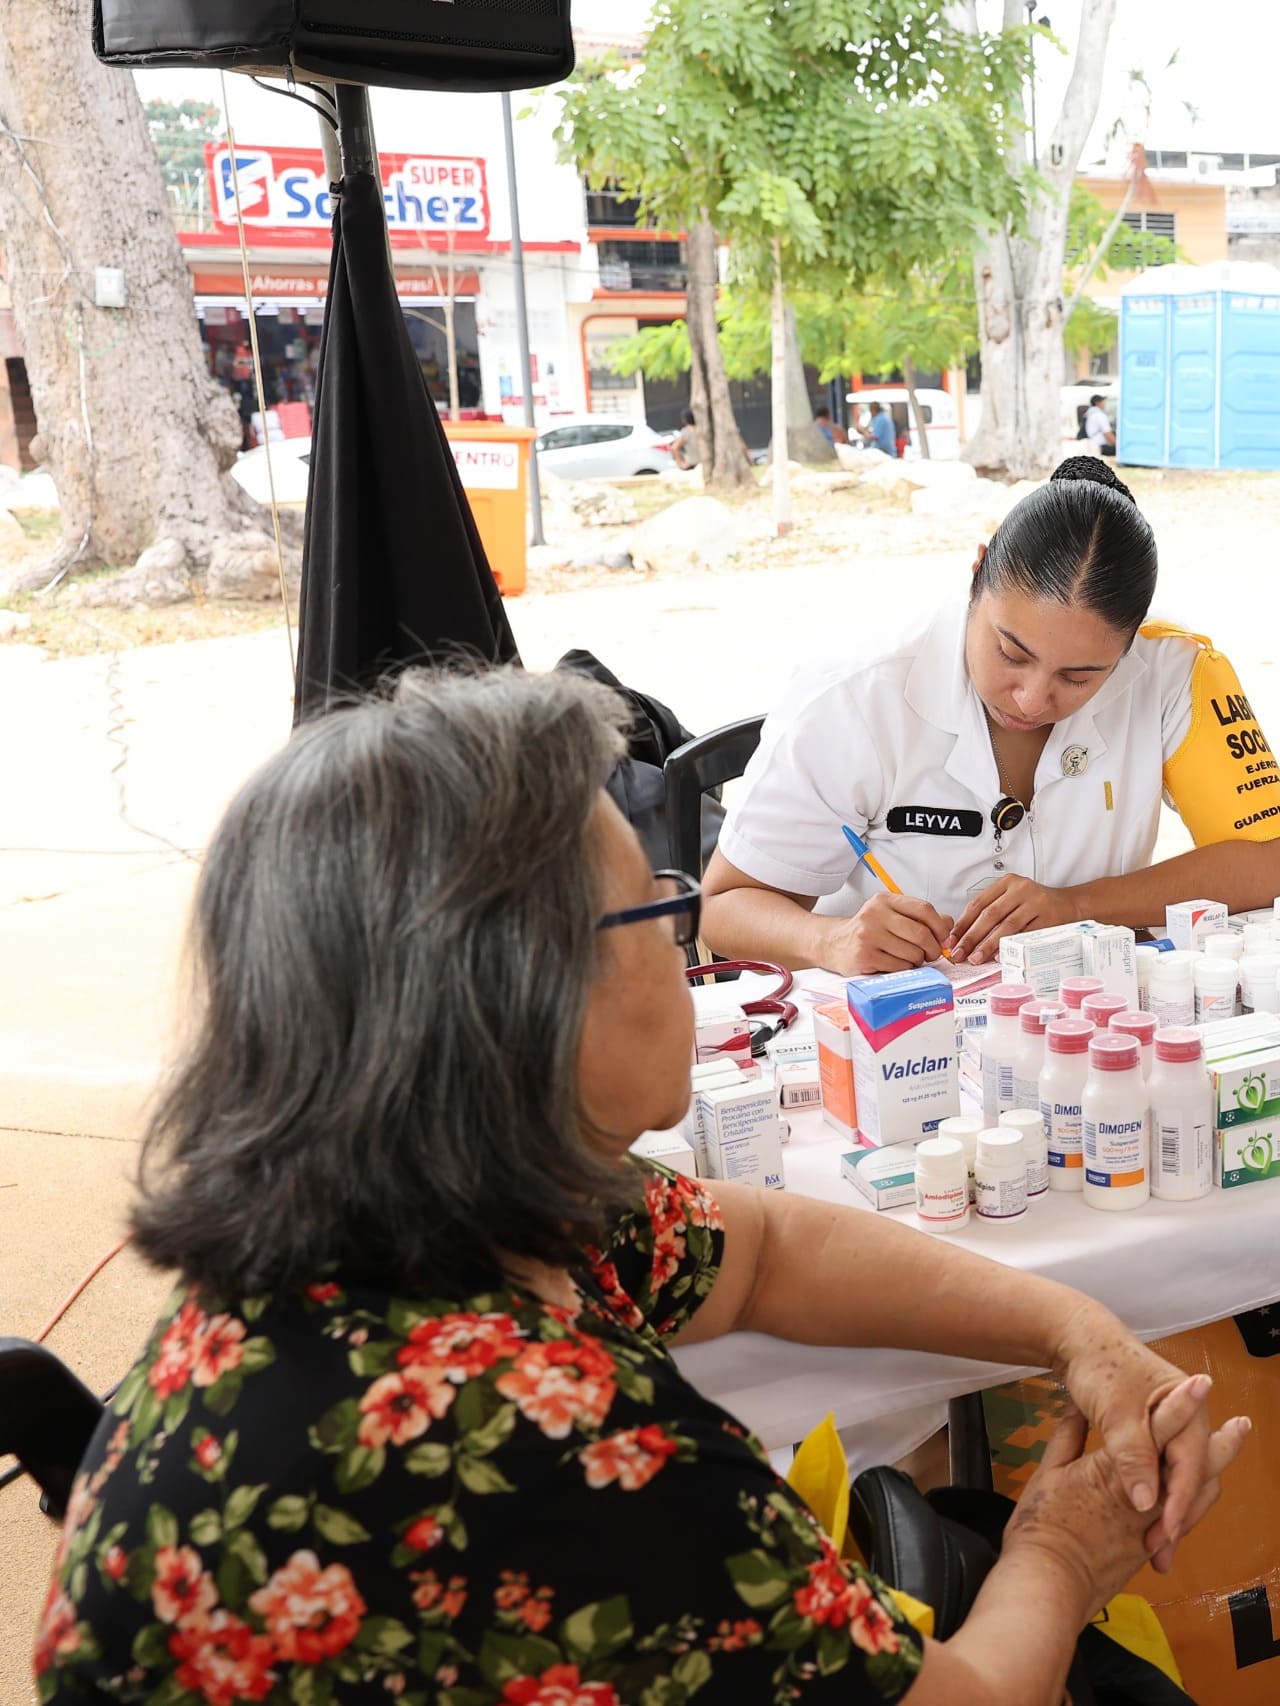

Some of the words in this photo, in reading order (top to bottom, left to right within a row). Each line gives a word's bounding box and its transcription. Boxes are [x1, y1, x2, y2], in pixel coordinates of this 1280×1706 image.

[410, 165, 475, 186] SUPER
[1211, 694, 1257, 726] LAB
[1236, 774, 1280, 794] FUERZA
[905, 812, 962, 830] LEYVA
[882, 1054, 949, 1082] Valclan
[1054, 1103, 1082, 1116] DIMO
[1098, 1120, 1142, 1135] DIMOPEN
